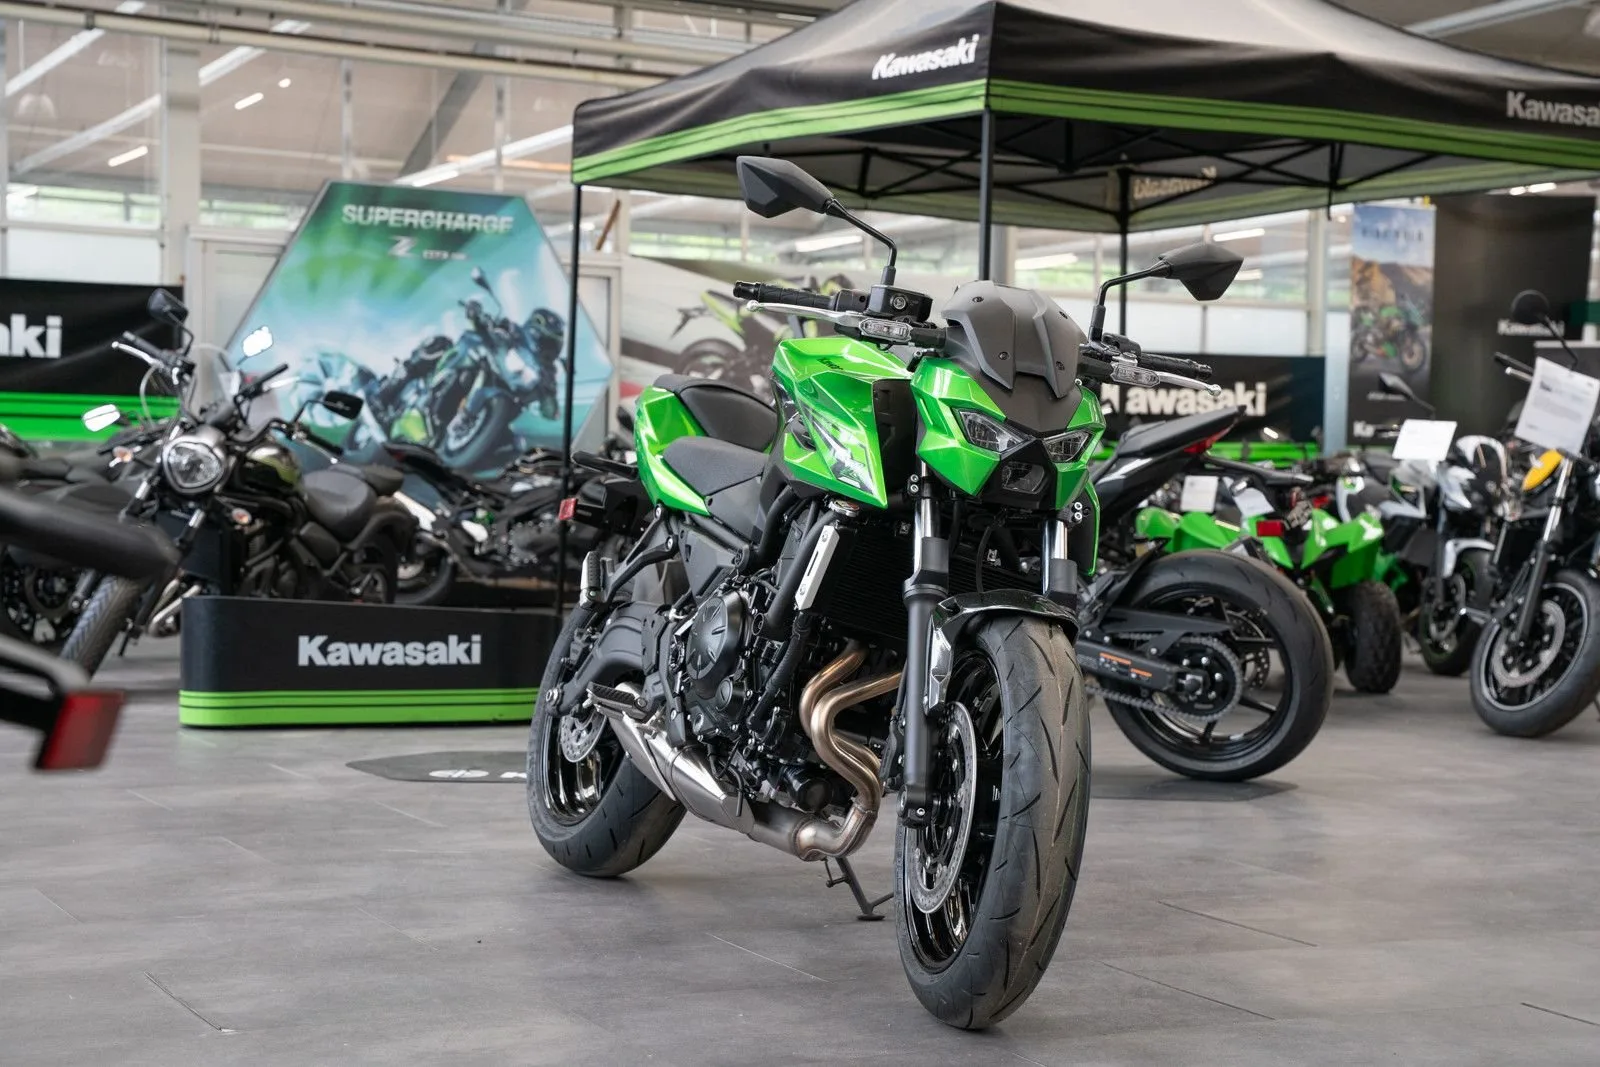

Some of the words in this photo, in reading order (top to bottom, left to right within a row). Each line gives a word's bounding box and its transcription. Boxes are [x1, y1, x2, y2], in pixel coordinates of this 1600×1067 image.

[872, 34, 980, 80] Kawasaki
[341, 203, 514, 234] SUPERCHARGE
[298, 634, 482, 666] Kawasaki
